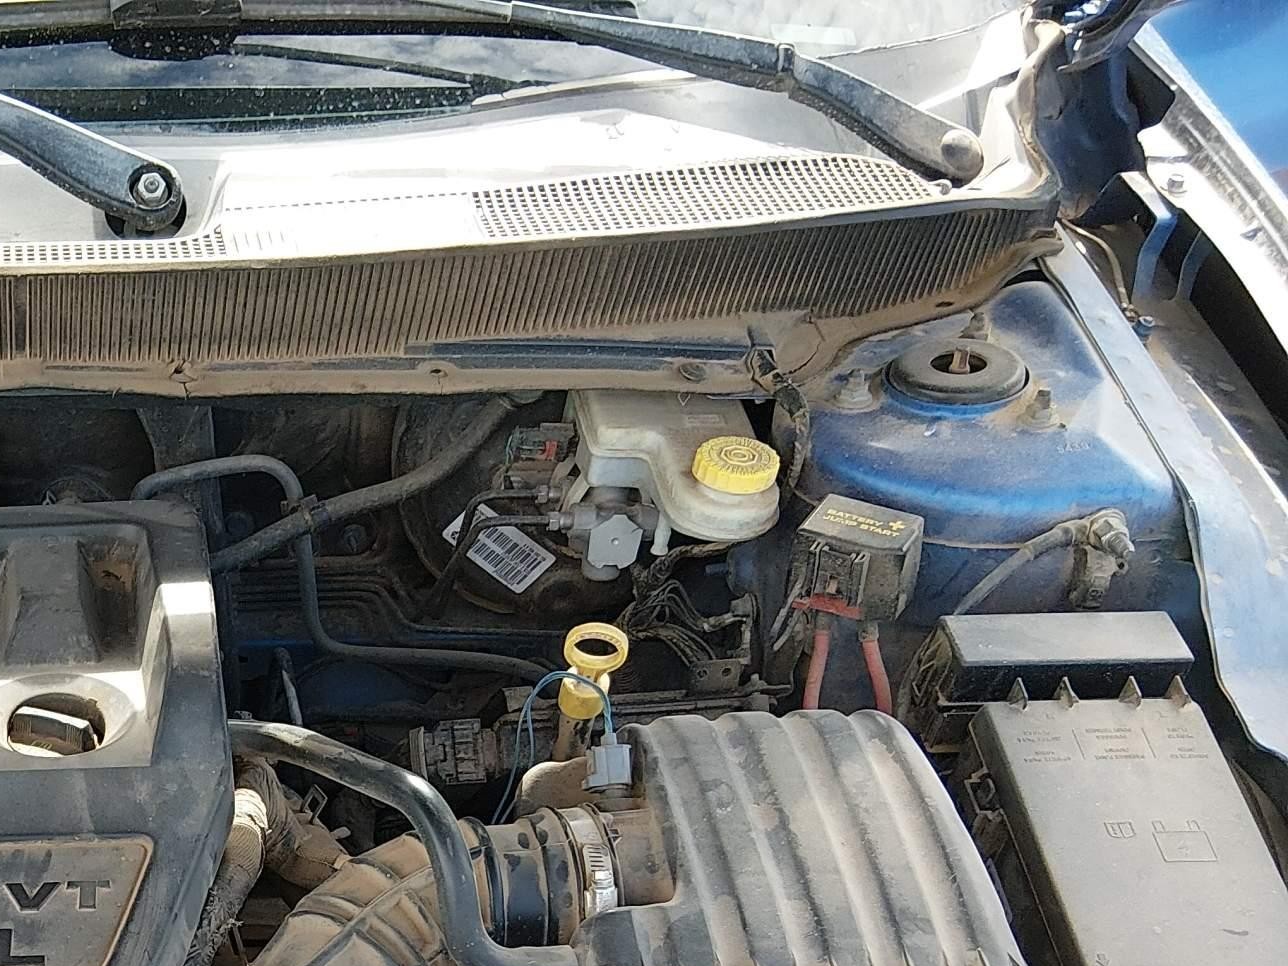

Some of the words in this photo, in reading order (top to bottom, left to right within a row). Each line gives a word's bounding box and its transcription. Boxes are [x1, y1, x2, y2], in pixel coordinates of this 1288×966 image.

[823, 515, 857, 526] JUMP
[859, 524, 900, 537] START
[827, 508, 884, 527] BATTERY
